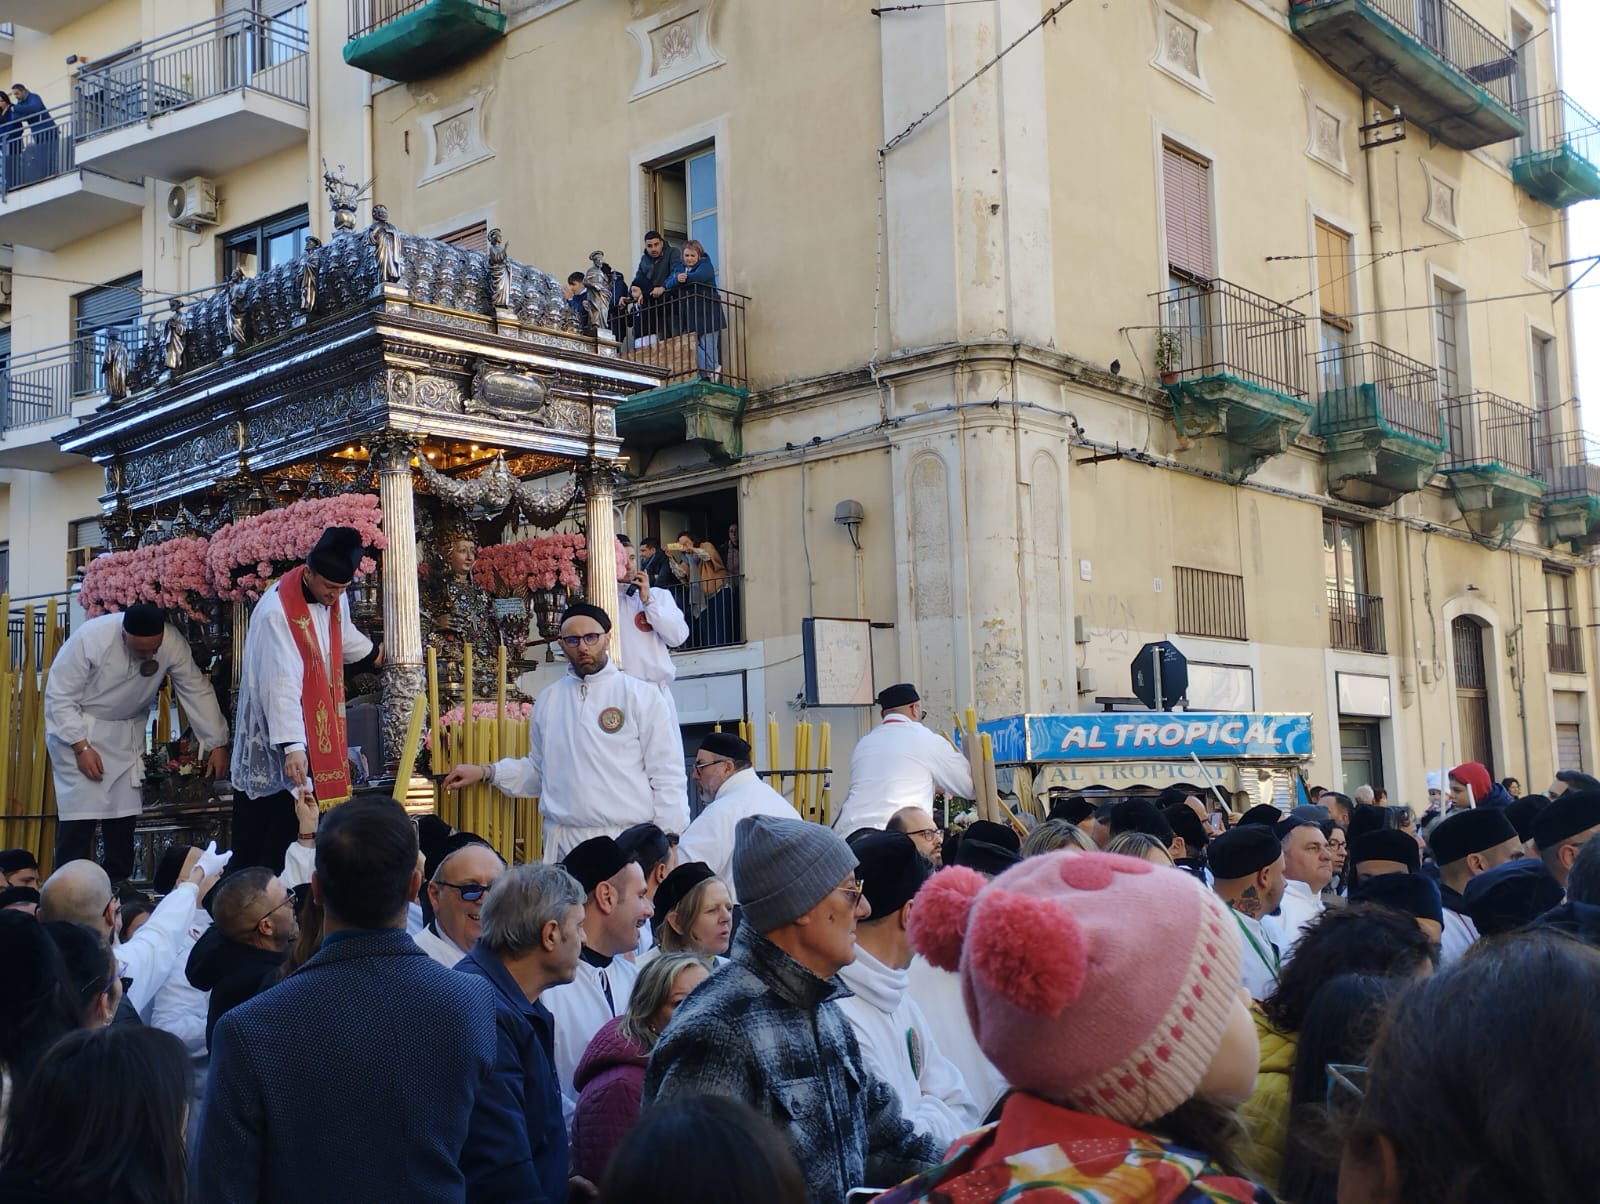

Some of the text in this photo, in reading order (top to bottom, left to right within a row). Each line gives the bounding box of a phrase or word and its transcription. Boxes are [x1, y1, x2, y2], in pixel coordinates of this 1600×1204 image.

[1061, 722, 1284, 750] AL TROPICAL
[1050, 766, 1084, 782] AL
